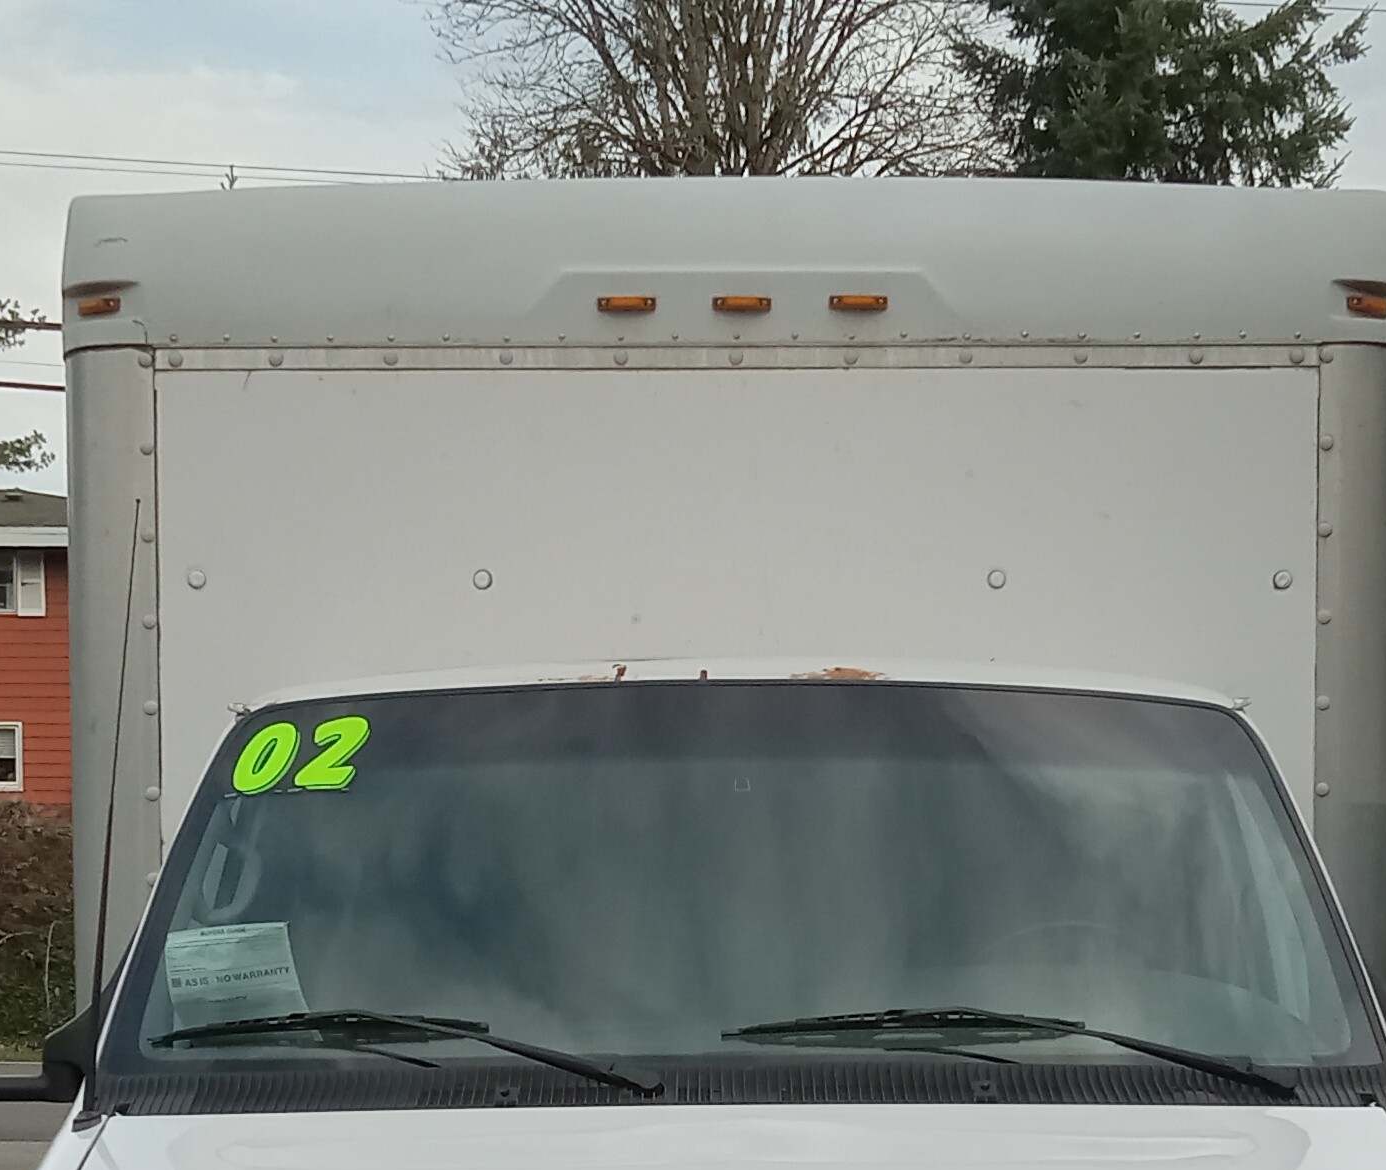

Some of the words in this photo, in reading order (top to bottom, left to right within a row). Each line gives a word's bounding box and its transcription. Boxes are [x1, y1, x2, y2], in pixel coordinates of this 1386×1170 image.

[231, 715, 371, 796] 02
[185, 978, 197, 987] AS
[200, 976, 209, 986] IS
[216, 974, 231, 983] NO
[232, 966, 290, 981] WARRANTY
